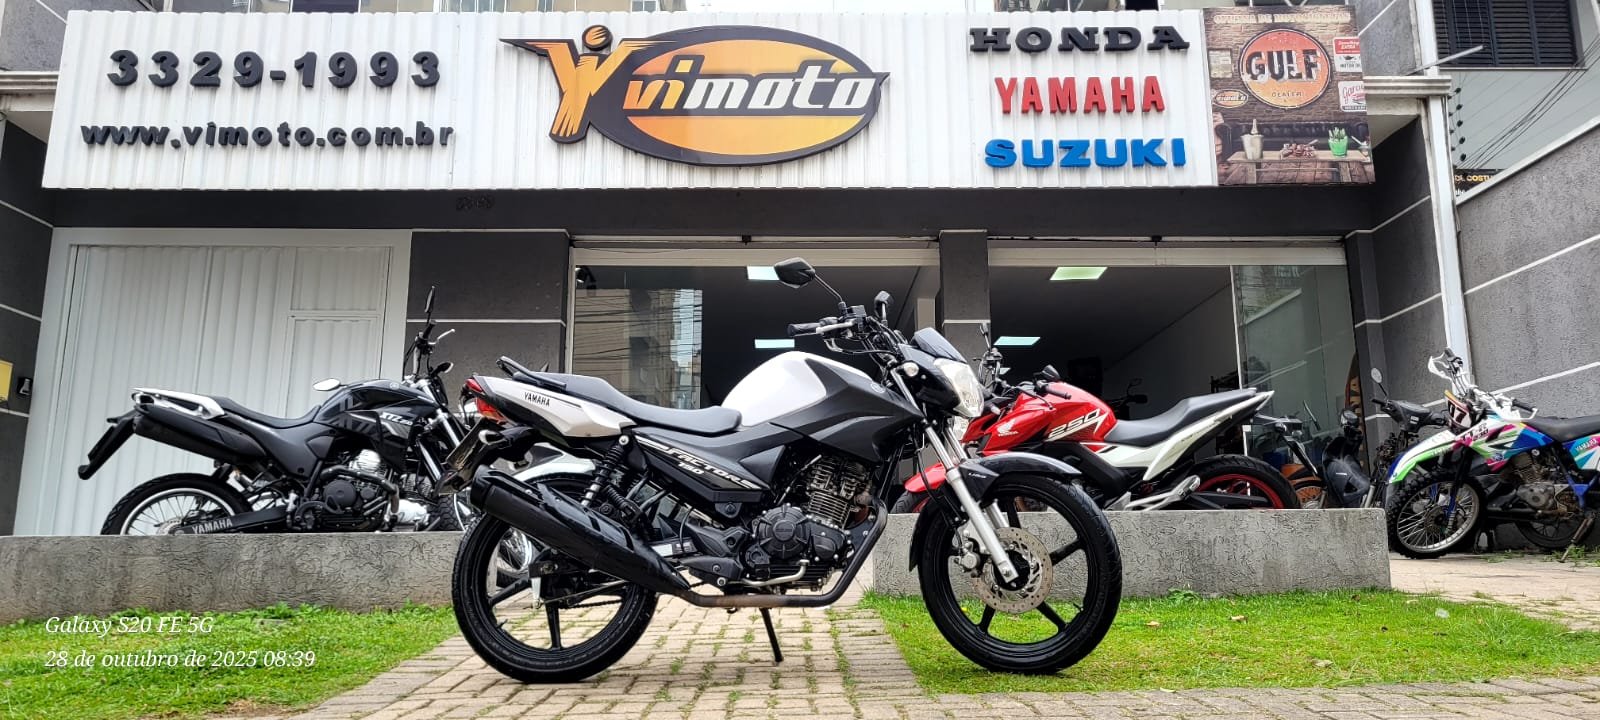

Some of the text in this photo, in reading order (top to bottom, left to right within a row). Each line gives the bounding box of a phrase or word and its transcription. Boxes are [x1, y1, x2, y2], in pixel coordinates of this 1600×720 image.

[970, 25, 1190, 53] HONDA
[107, 49, 441, 89] 3329-1993
[1245, 49, 1321, 84] GULF
[622, 59, 875, 109] vimoto
[995, 75, 1165, 114] YAMAHA
[81, 120, 454, 149] www.vimoto.com.br
[984, 137, 1186, 169] SUZUKI
[524, 391, 551, 407] YAMAHA
[380, 411, 403, 424] XTZ
[1048, 408, 1100, 438] 250
[192, 518, 232, 534] YAMAHA
